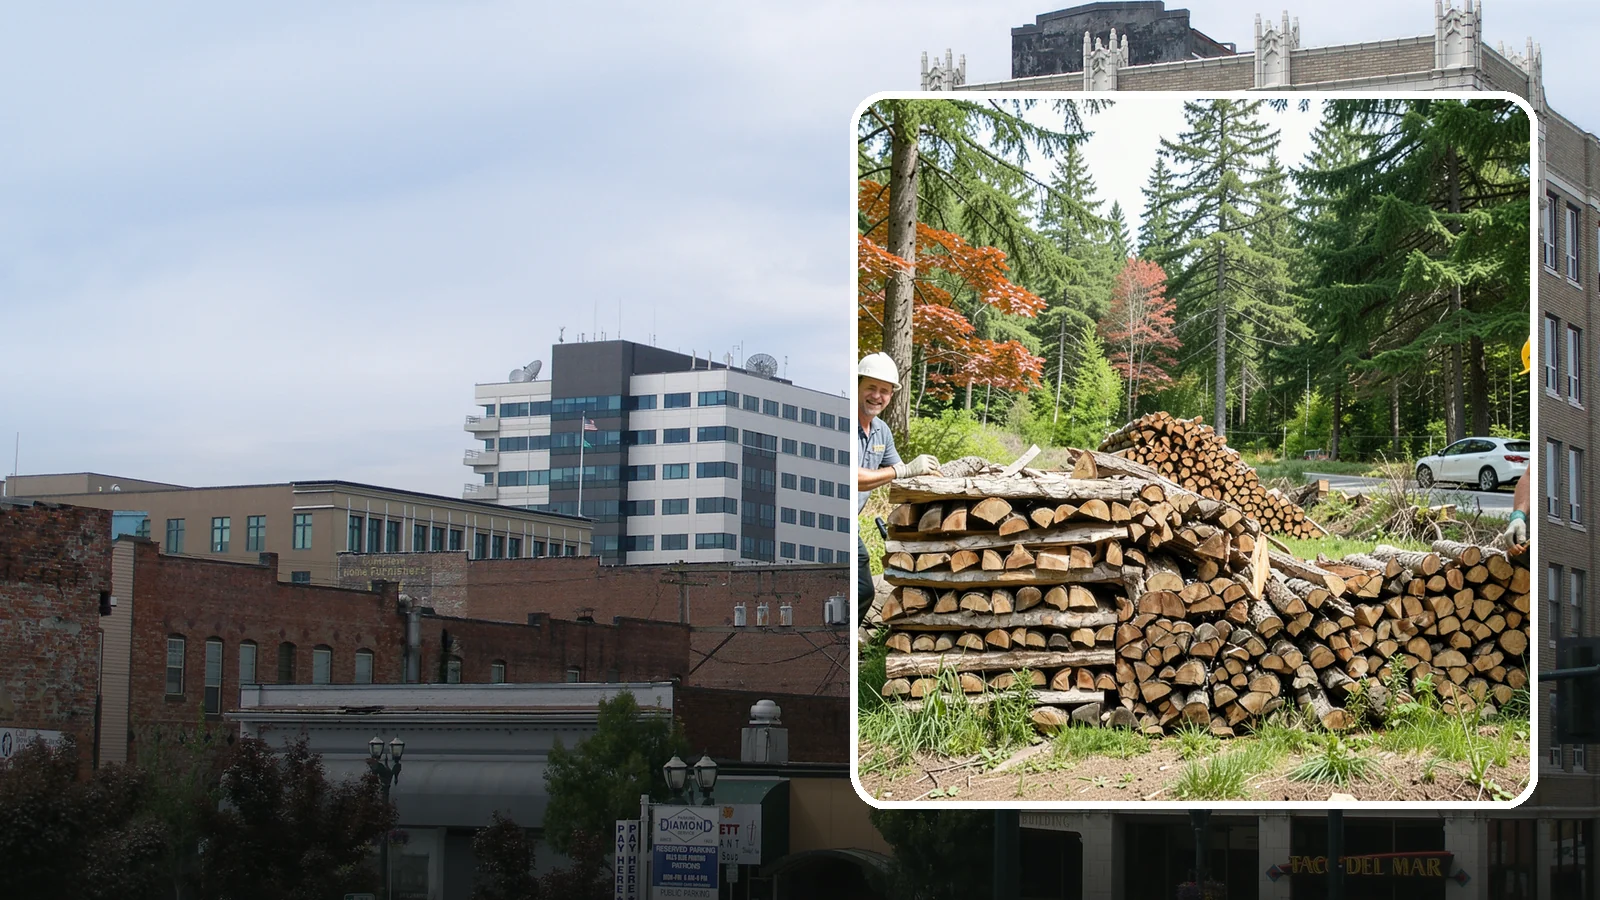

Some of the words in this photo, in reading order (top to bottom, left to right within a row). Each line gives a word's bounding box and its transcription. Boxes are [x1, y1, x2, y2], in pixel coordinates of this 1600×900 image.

[343, 567, 368, 577] Home
[370, 566, 427, 577] Furnishers
[660, 818, 713, 833] DIAMOND
[1021, 815, 1070, 828] BUILDING
[617, 825, 625, 852] PAY
[628, 824, 637, 852] PAY
[656, 845, 688, 853] RESERVED
[689, 846, 716, 854] PARKING
[721, 851, 739, 862] Soup
[671, 862, 701, 870] PATRONS
[1345, 857, 1385, 876] DEL
[1392, 857, 1442, 877] MAR
[616, 856, 625, 893] HERE
[628, 855, 636, 893] HERE
[660, 889, 682, 897] PUBLIC
[684, 890, 710, 898] PARKING
